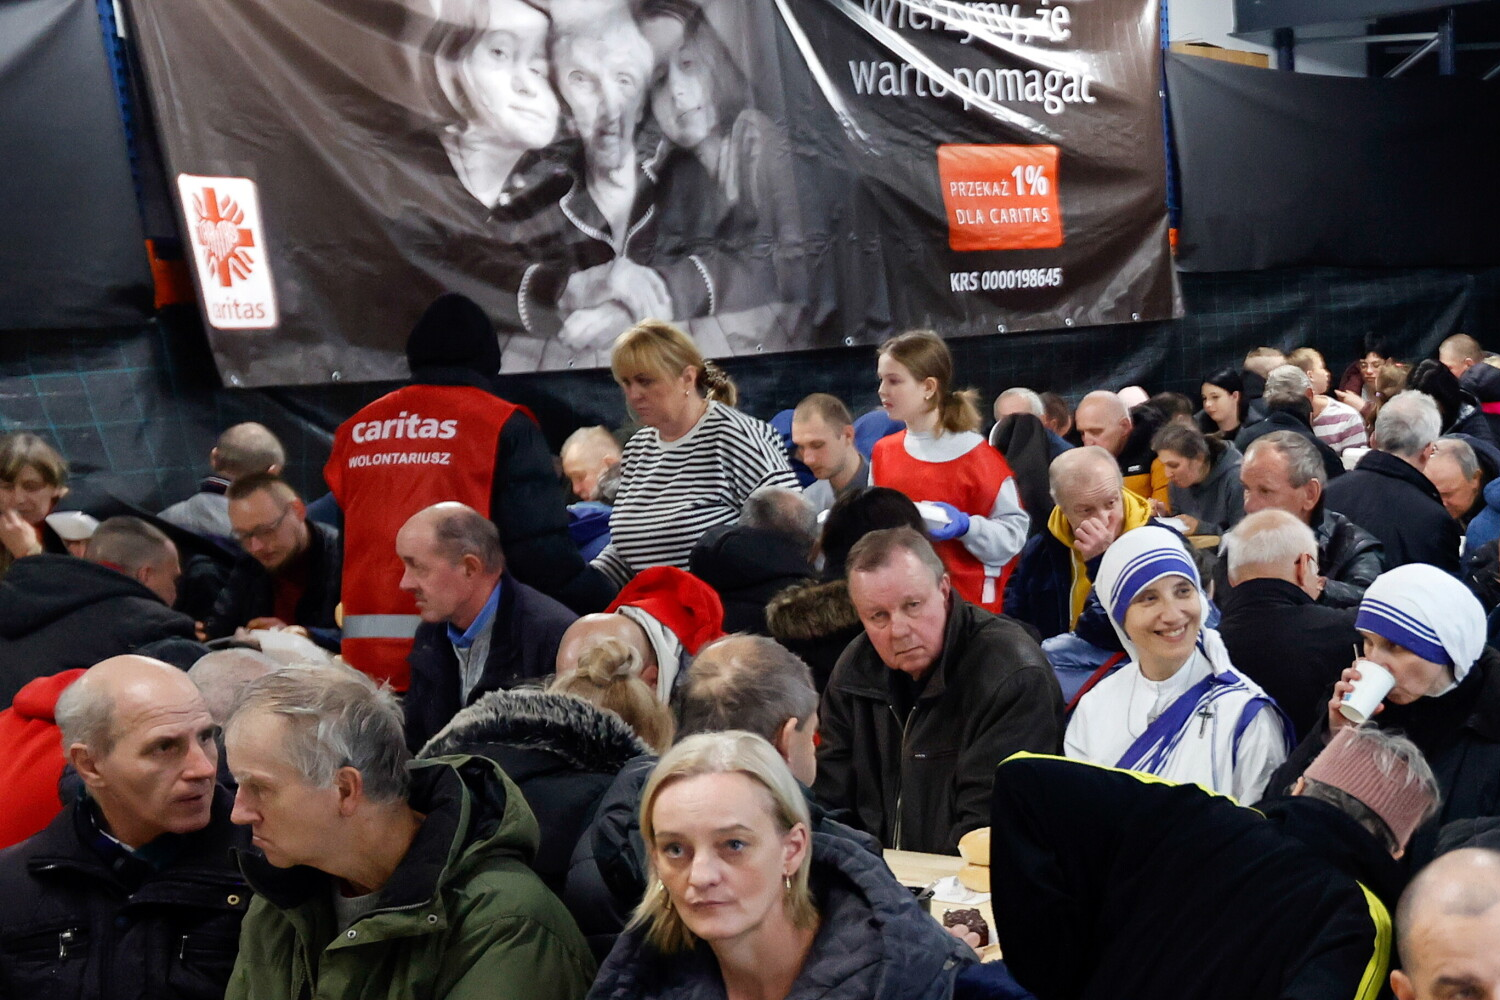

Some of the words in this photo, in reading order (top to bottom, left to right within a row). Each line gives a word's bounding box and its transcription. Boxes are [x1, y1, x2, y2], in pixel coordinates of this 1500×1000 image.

[950, 179, 1011, 197] PRZEKAŻ
[1011, 165, 1049, 196] 1%
[956, 209, 984, 225] DLA
[989, 207, 1049, 224] CARITAS
[950, 271, 978, 292] KRS
[981, 268, 1062, 291] 0000198645
[351, 411, 458, 444] caritas
[348, 451, 452, 468] WOLONTARIUSZ
